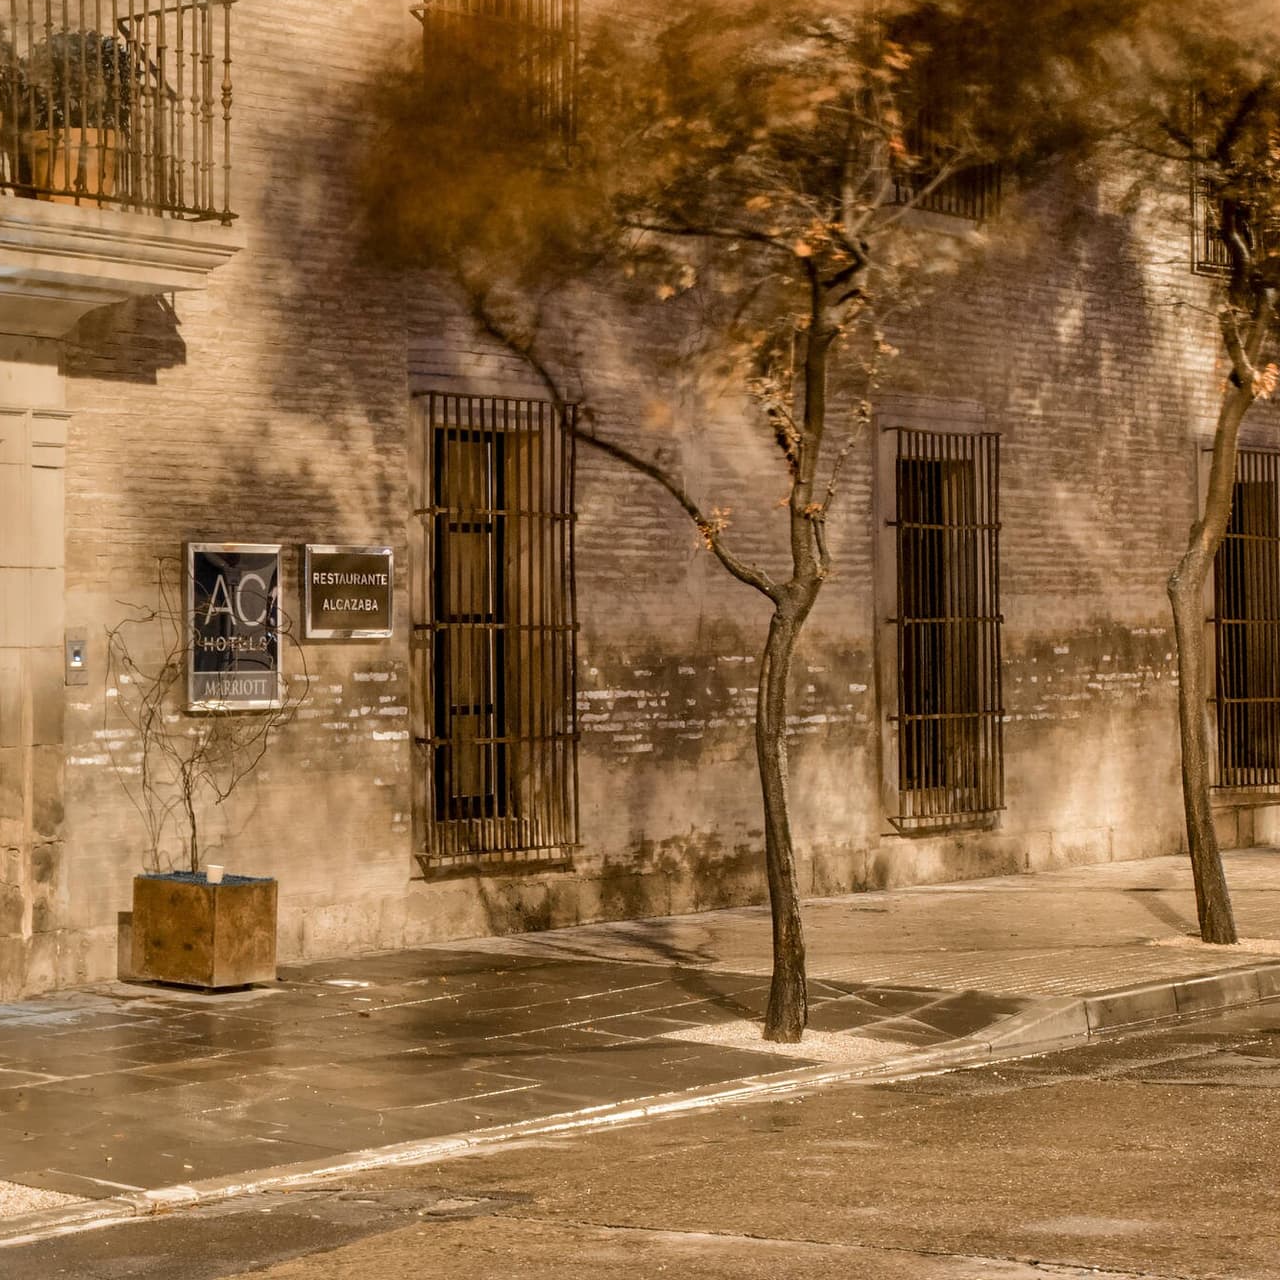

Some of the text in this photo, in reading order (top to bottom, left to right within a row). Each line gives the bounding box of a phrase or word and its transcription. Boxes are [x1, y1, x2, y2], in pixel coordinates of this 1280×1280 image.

[312, 572, 388, 586] RESTAURANTE
[204, 573, 267, 627] AC
[322, 598, 379, 612] ALCAZABA
[204, 679, 268, 696] MARRIOTT
